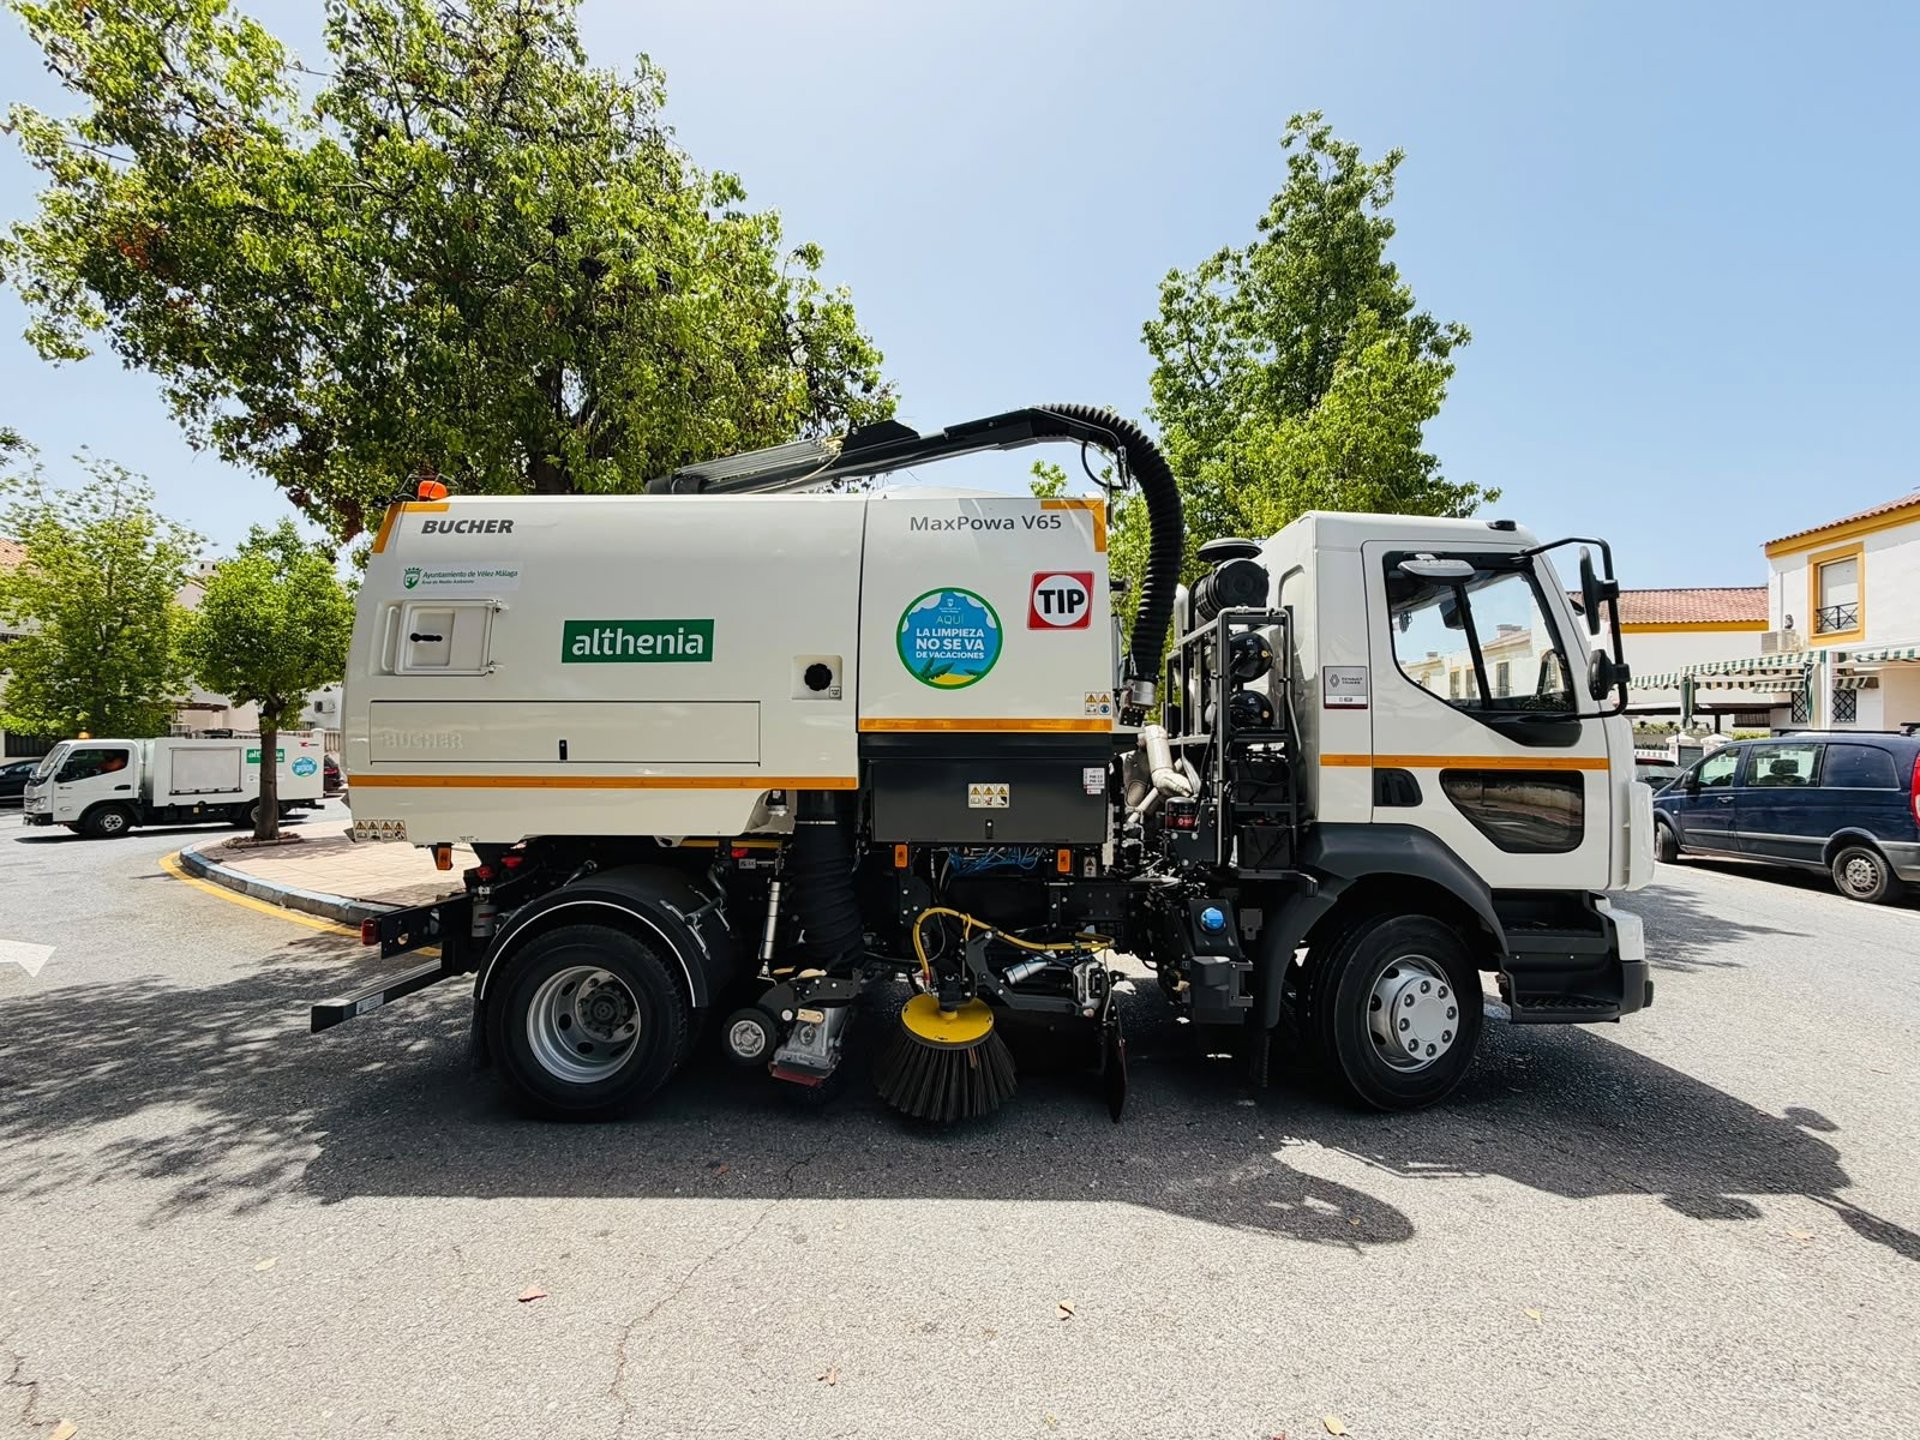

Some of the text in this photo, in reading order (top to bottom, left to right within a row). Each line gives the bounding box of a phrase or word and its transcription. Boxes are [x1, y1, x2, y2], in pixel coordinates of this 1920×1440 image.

[421, 519, 514, 534] BUCHER
[909, 514, 1062, 531] MaxPowa V65
[423, 570, 467, 579] Ayuntamiento
[495, 569, 518, 578] Málaga
[1038, 588, 1086, 614] TIP
[936, 613, 965, 625] AQUÍ
[916, 628, 985, 638] LA LIMPIEZA
[571, 627, 704, 656] althenia
[916, 638, 985, 651] NO SE VA
[915, 651, 985, 659] DE VACACIONES
[382, 731, 464, 750] BUCHER
